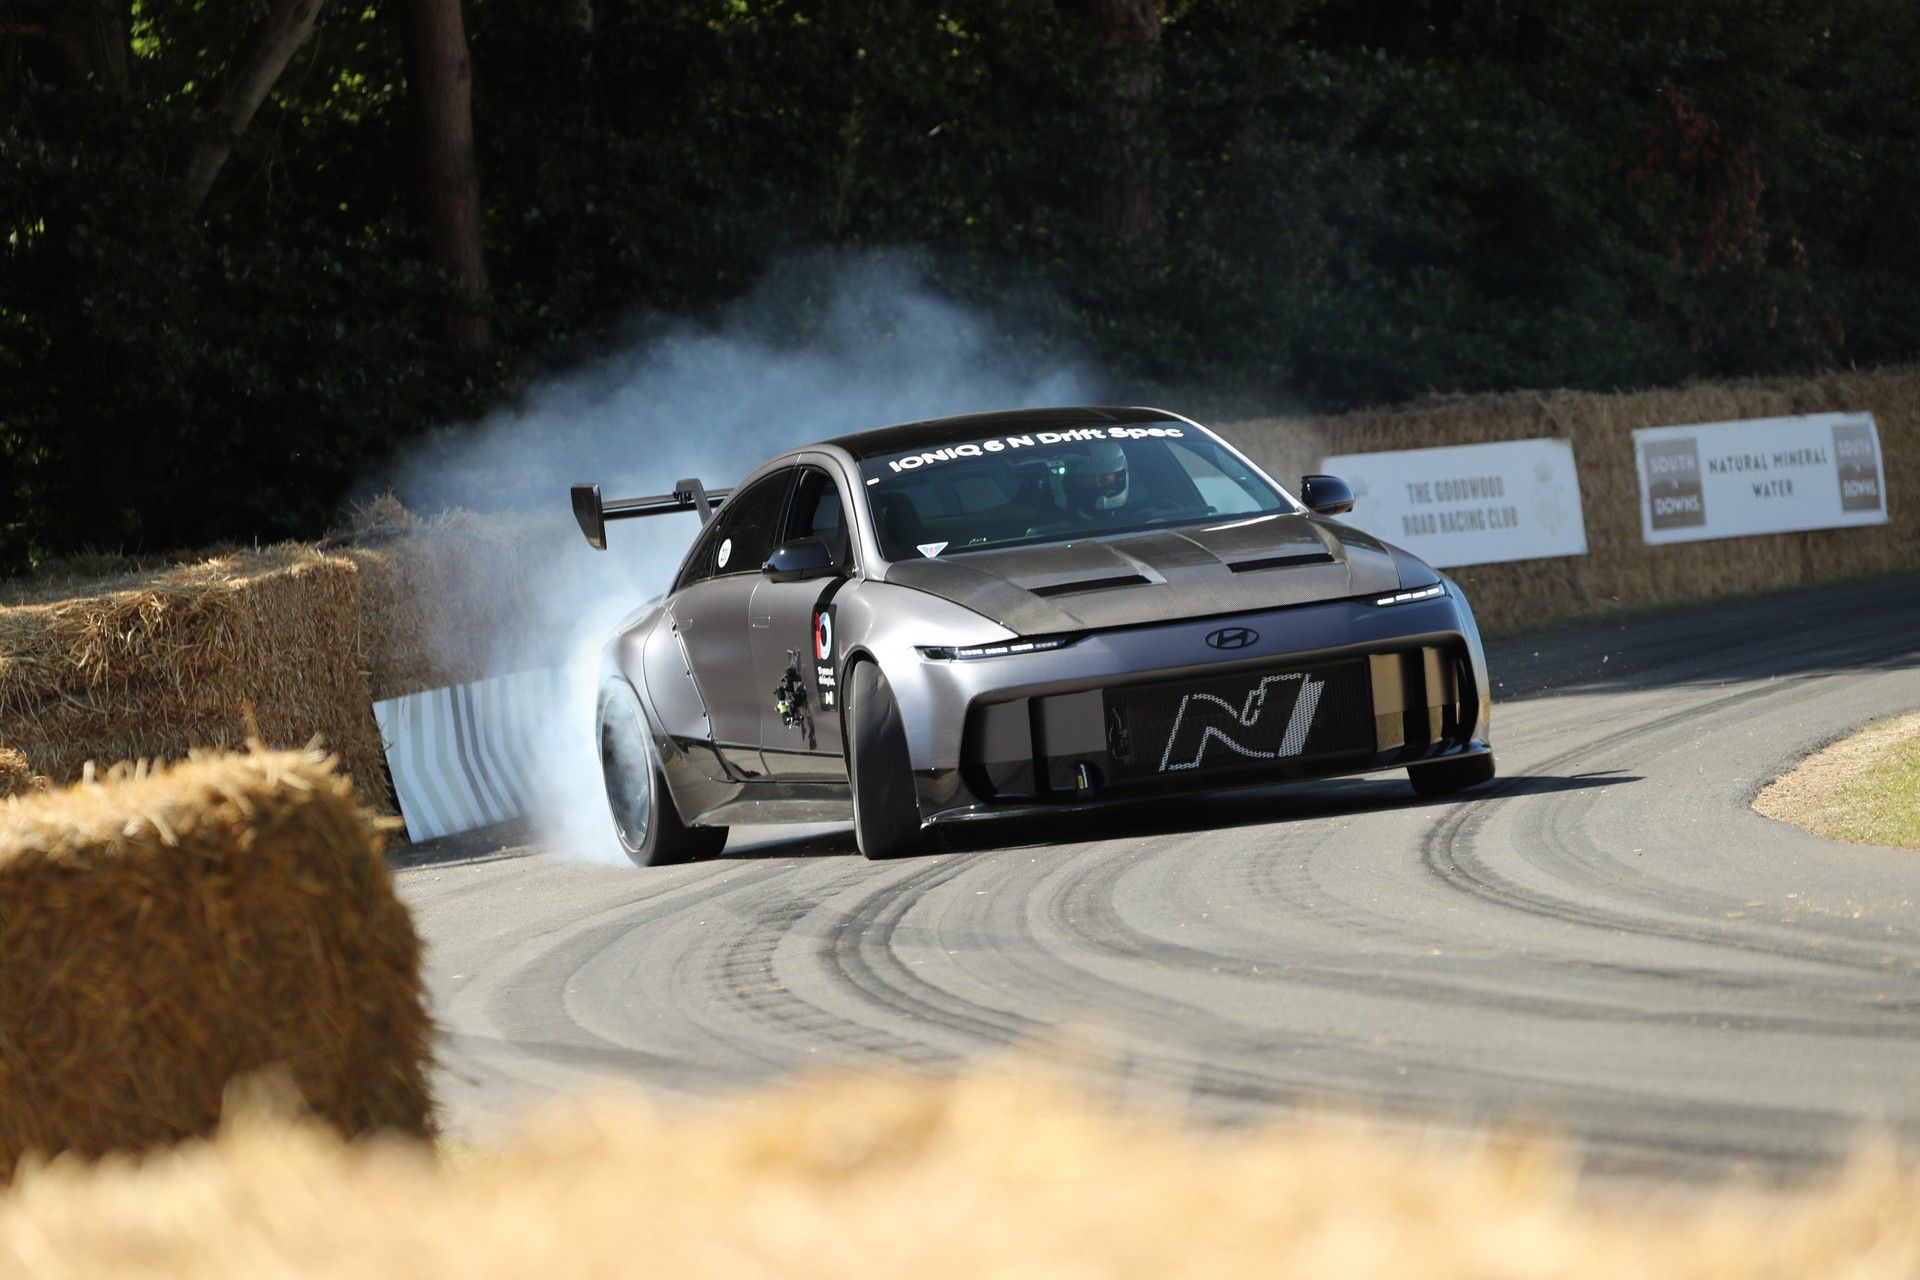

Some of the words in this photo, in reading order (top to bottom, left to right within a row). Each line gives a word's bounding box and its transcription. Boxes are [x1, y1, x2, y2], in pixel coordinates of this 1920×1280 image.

[889, 444, 983, 472] IONIQ
[983, 440, 1005, 452] 6
[1006, 435, 1035, 448] N
[1036, 428, 1106, 444] Drift
[1108, 427, 1184, 440] Spec
[1707, 453, 1768, 475] NATURAL
[1772, 447, 1827, 469] MINERAL
[1650, 453, 1696, 475] SOUTH
[1406, 481, 1433, 505] THE
[1434, 476, 1505, 503] GOODWOOD
[1752, 478, 1794, 499] WATER
[1654, 495, 1701, 516] DOWNS
[1401, 512, 1438, 537] ROAD
[1440, 508, 1486, 534] RACING
[1487, 505, 1519, 530] CLUB
